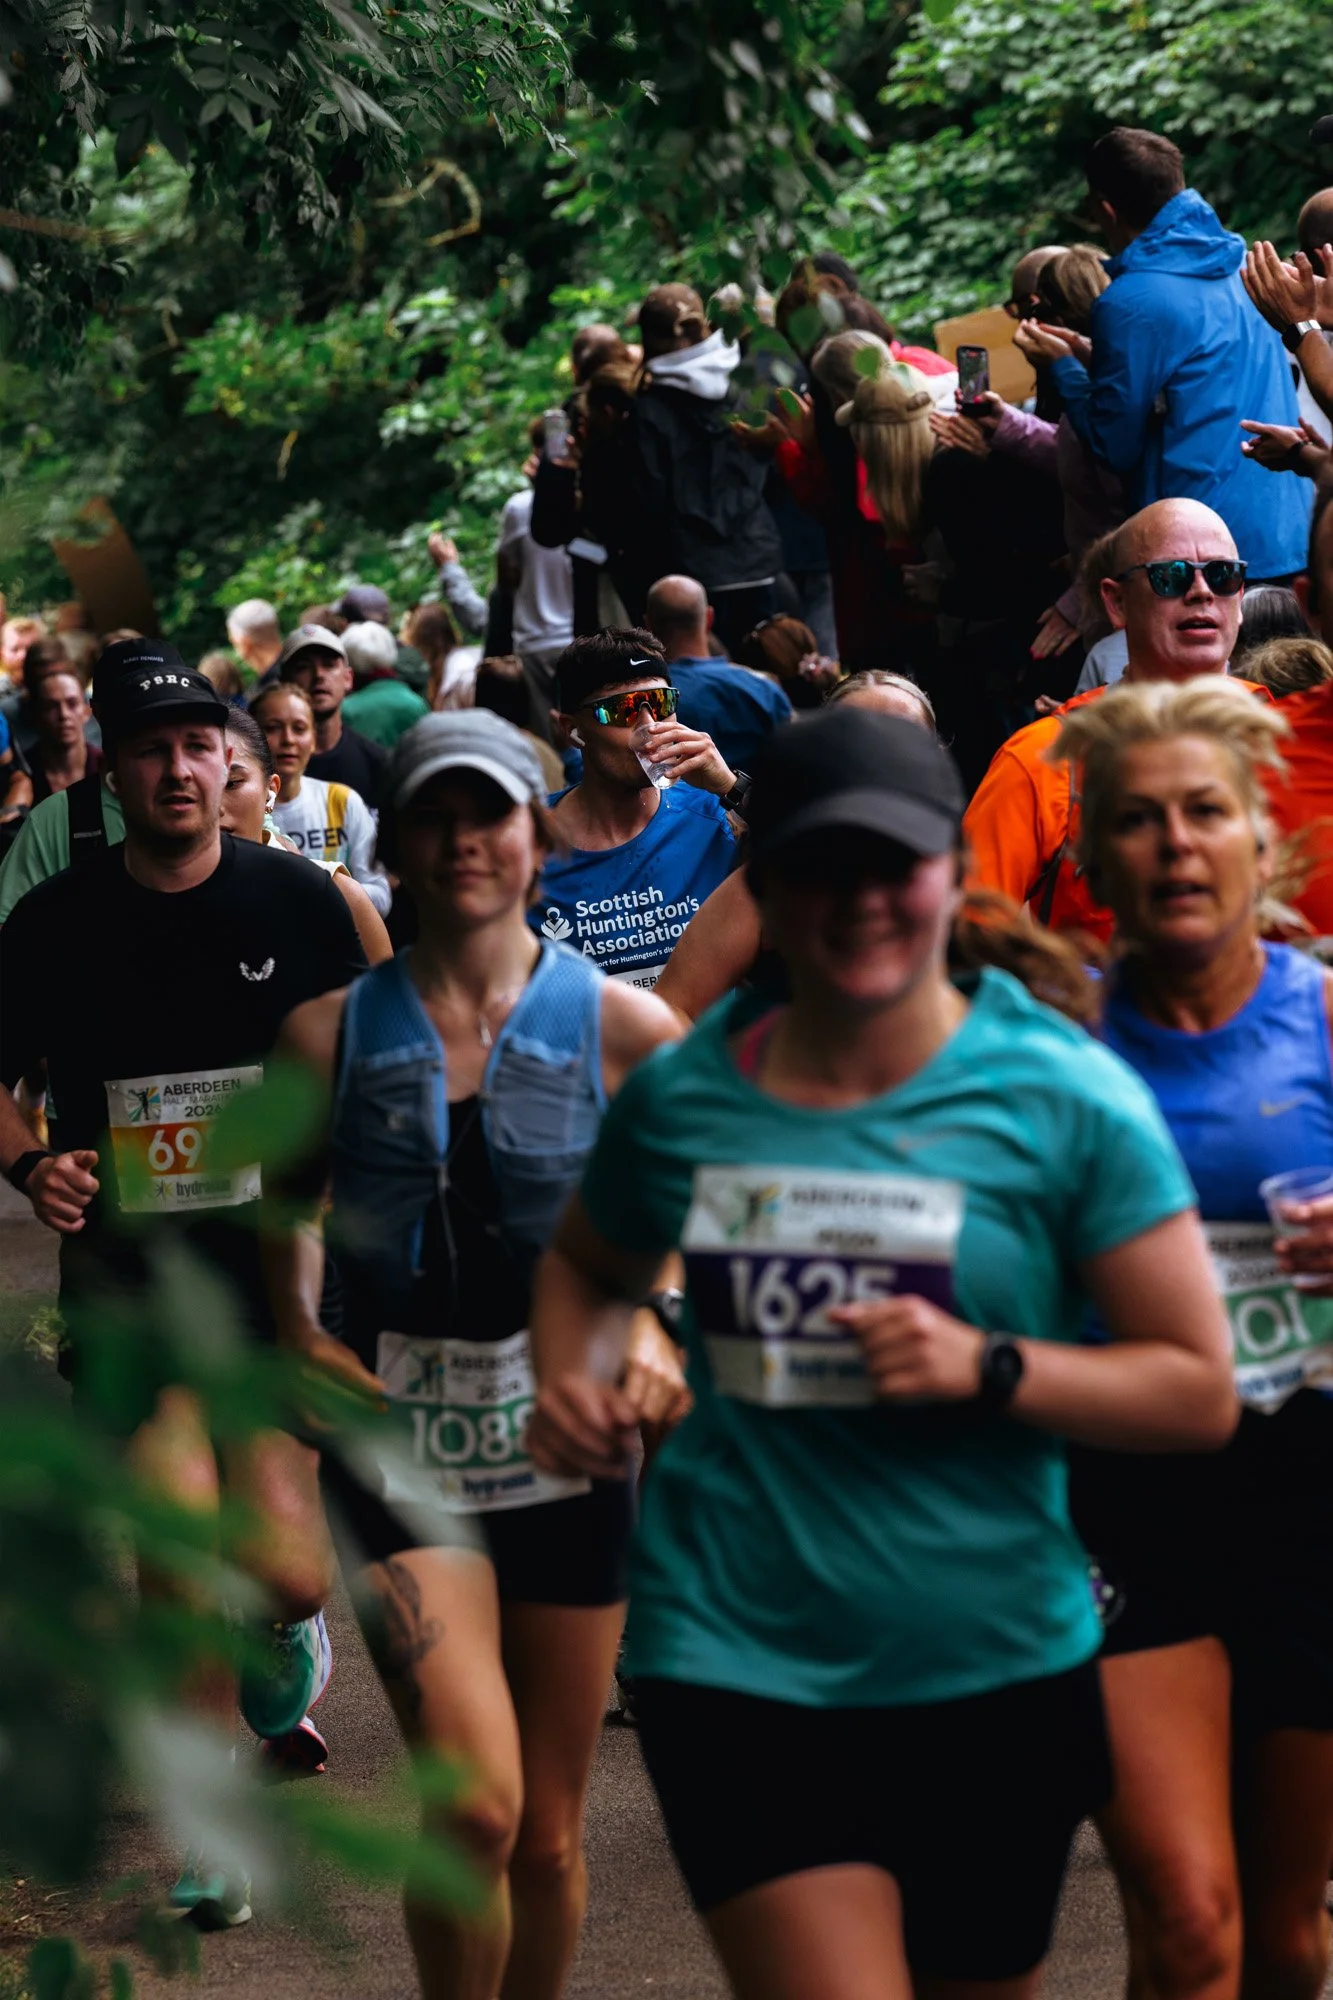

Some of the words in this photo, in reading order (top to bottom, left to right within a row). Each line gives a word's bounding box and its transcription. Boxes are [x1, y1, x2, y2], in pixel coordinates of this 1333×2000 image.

[140, 674, 190, 691] PSRC
[575, 886, 664, 918] Scottish
[576, 895, 700, 938] Huntington's
[609, 957, 620, 966] for
[620, 948, 663, 964] Huntington's
[663, 945, 676, 955] dis
[163, 1078, 241, 1096] ABERDEEN
[729, 1258, 898, 1334] 1625
